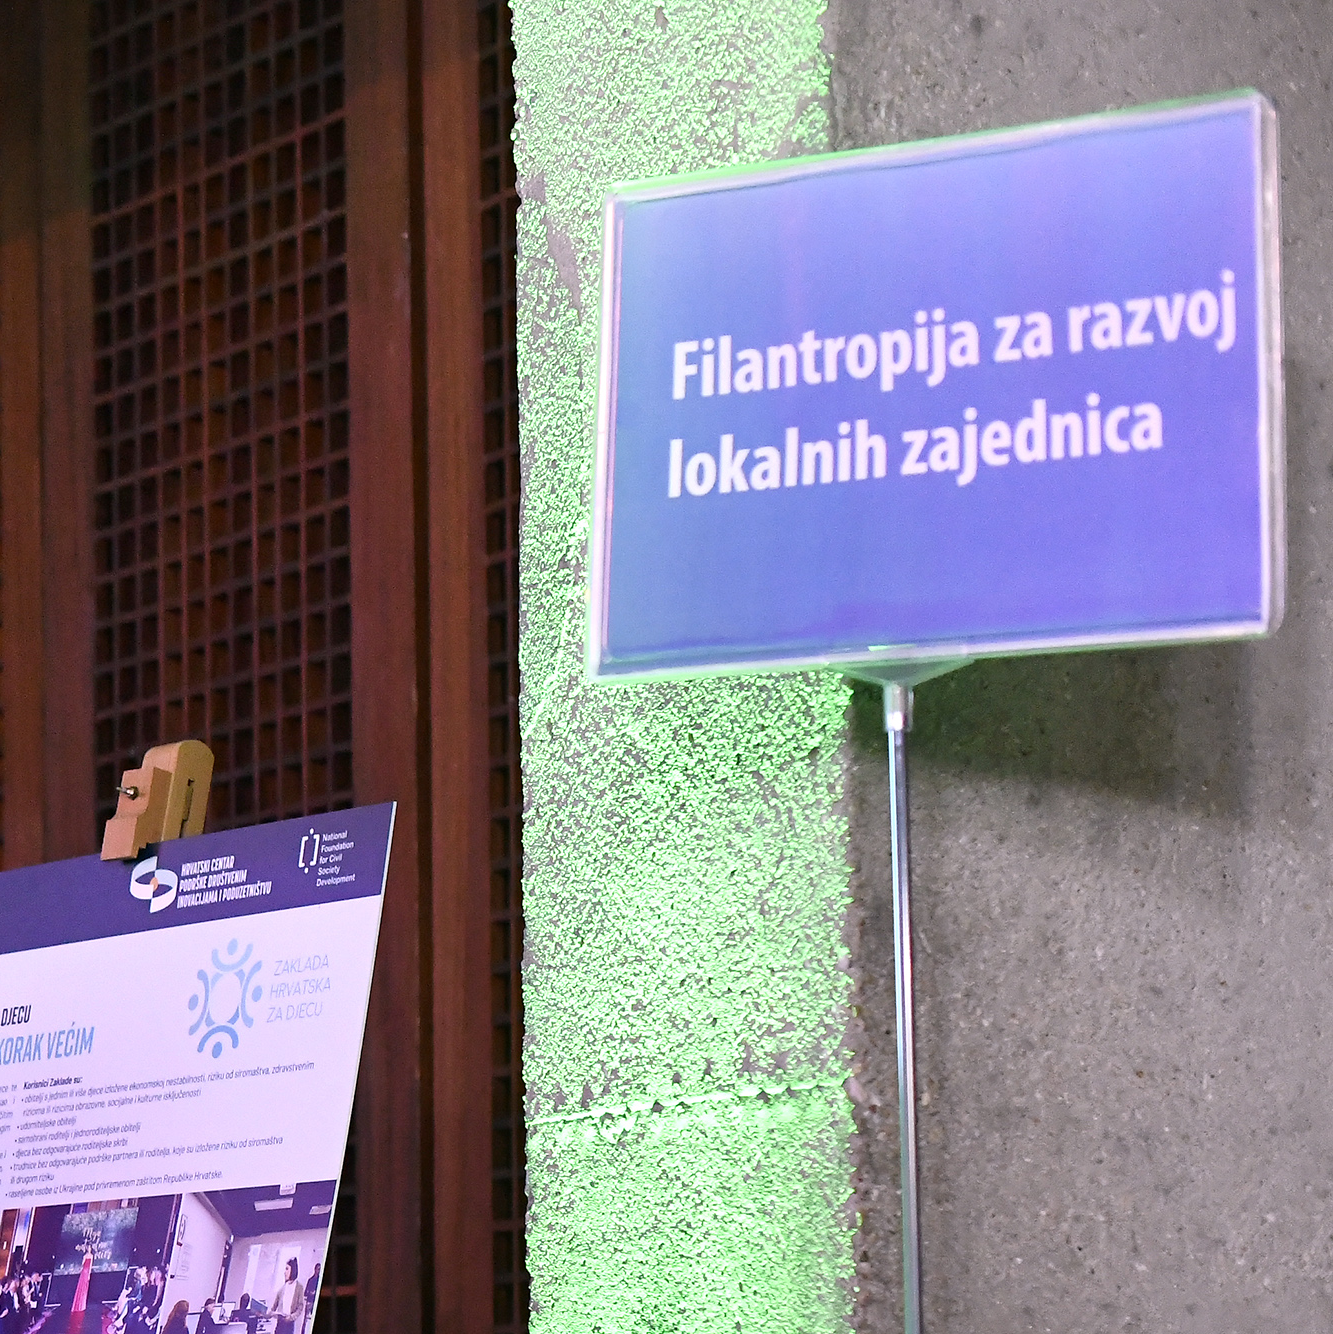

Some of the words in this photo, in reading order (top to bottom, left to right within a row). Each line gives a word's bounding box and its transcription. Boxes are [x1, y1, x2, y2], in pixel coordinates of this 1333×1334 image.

[671, 309, 981, 402] Filantropija
[994, 311, 1054, 364] za
[1068, 270, 1237, 353] razvoj
[667, 419, 887, 499] lokalnih
[900, 392, 1164, 487] zajednica
[322, 830, 348, 841] National
[320, 841, 354, 853] Foundation
[181, 859, 211, 876] HRVATSKI
[210, 855, 235, 872] CENTAR
[318, 854, 329, 865] for
[329, 852, 343, 863] Civil
[317, 873, 356, 886] Development
[318, 864, 341, 875] Society
[273, 954, 329, 977] ZAKLADA
[269, 977, 331, 998] HRVATSKA
[0, 1005, 32, 1027] DJECU
[266, 1006, 283, 1024] ZA
[285, 1001, 323, 1021] DJECU
[47, 1022, 95, 1059] VEĆIM
